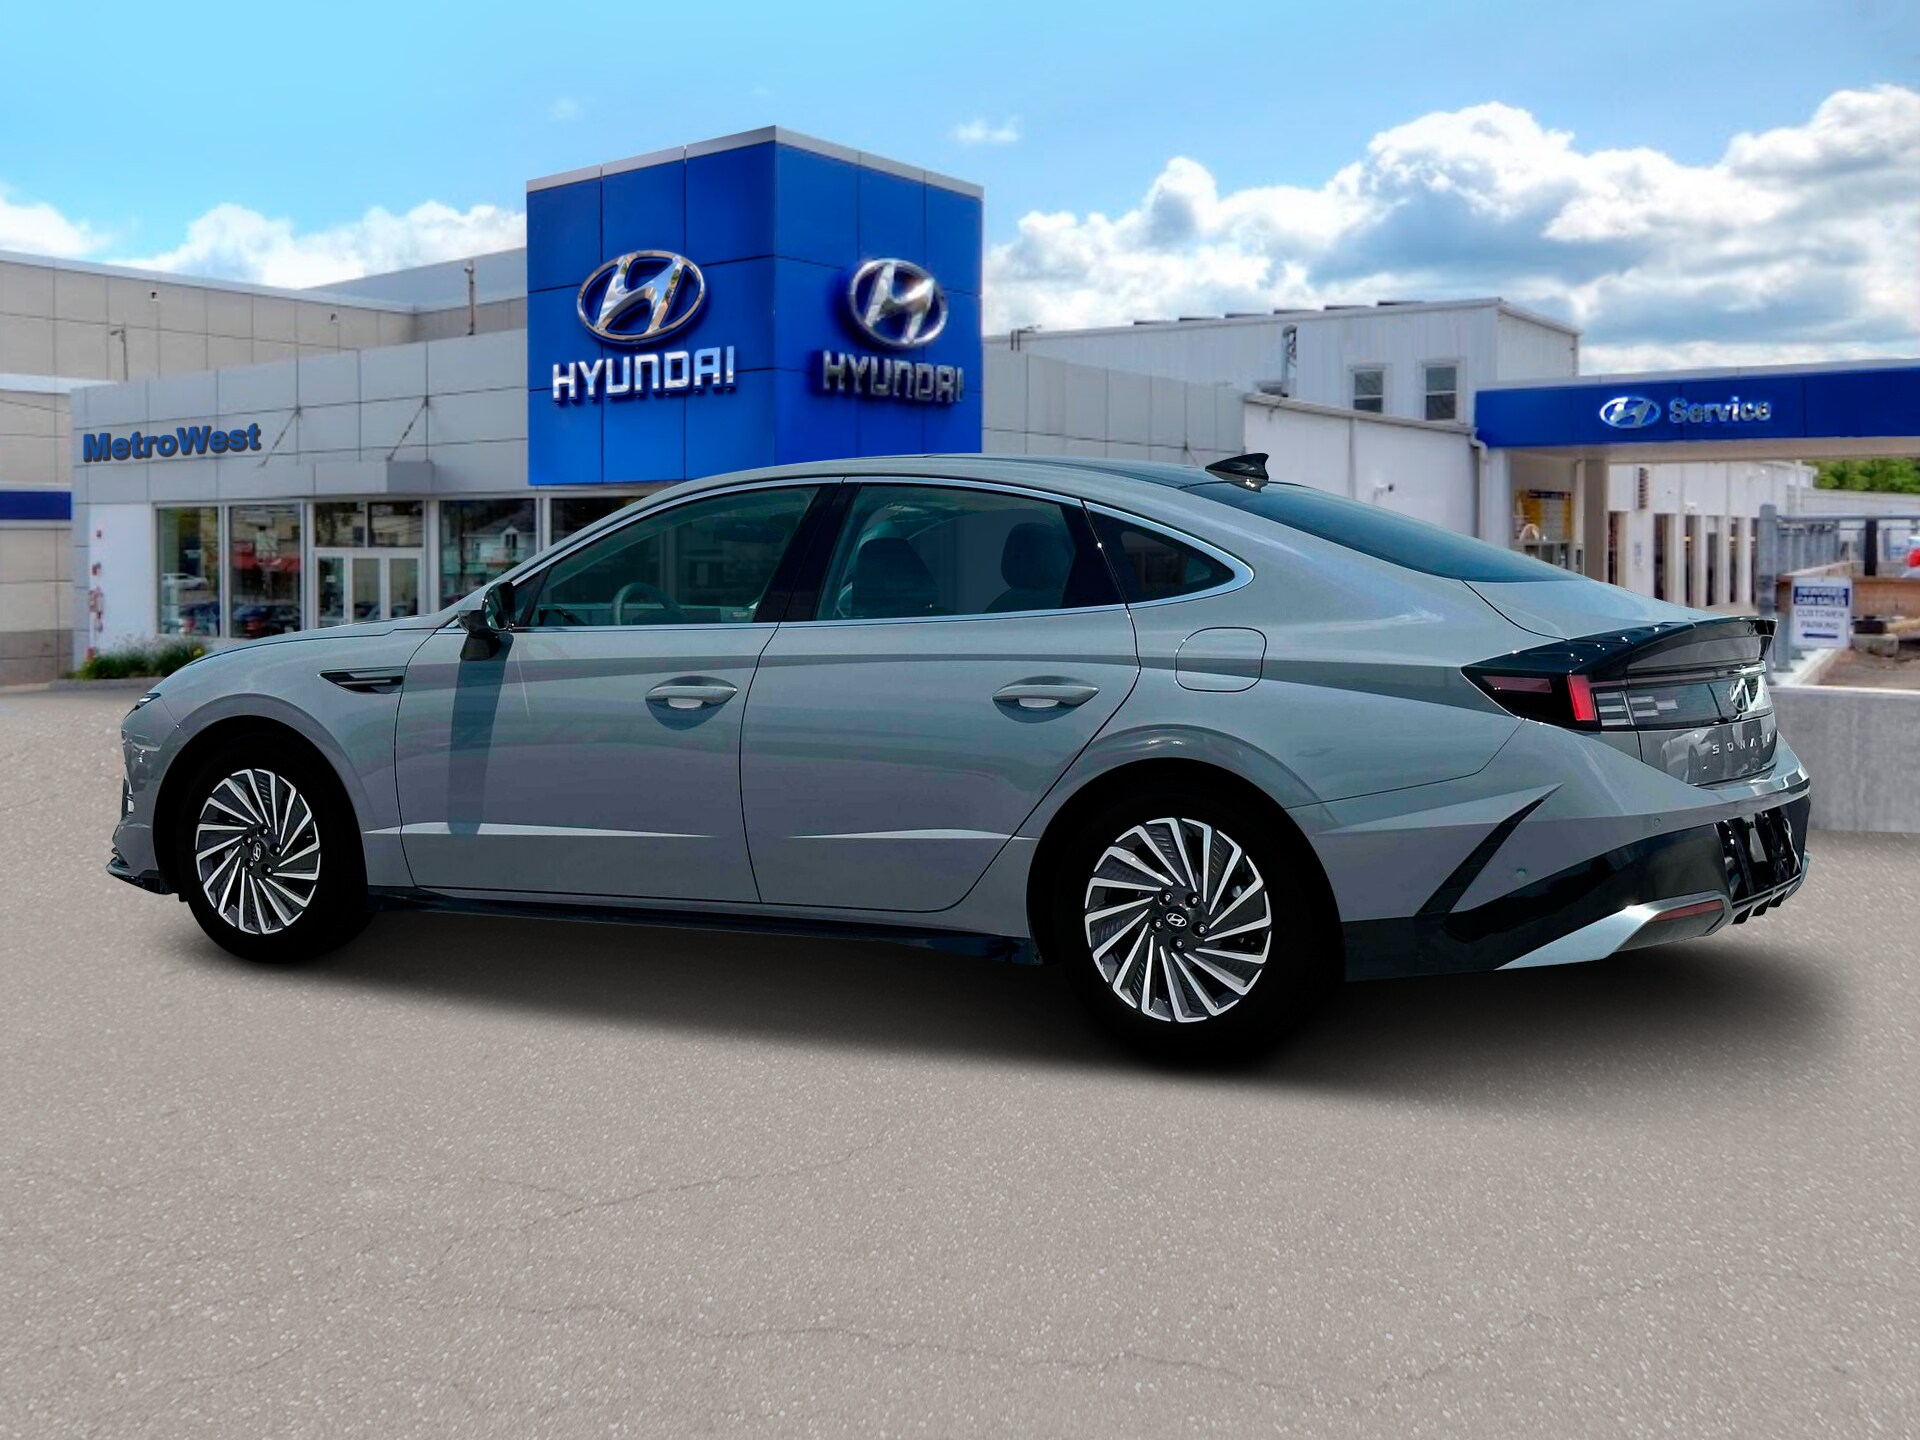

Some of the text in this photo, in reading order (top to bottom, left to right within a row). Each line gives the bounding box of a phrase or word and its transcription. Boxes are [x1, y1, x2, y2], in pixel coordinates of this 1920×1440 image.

[552, 345, 735, 400] HYUNDAI
[822, 350, 965, 403] HYUNDAI
[1669, 396, 1772, 423] Service
[83, 423, 262, 463] MetroWest
